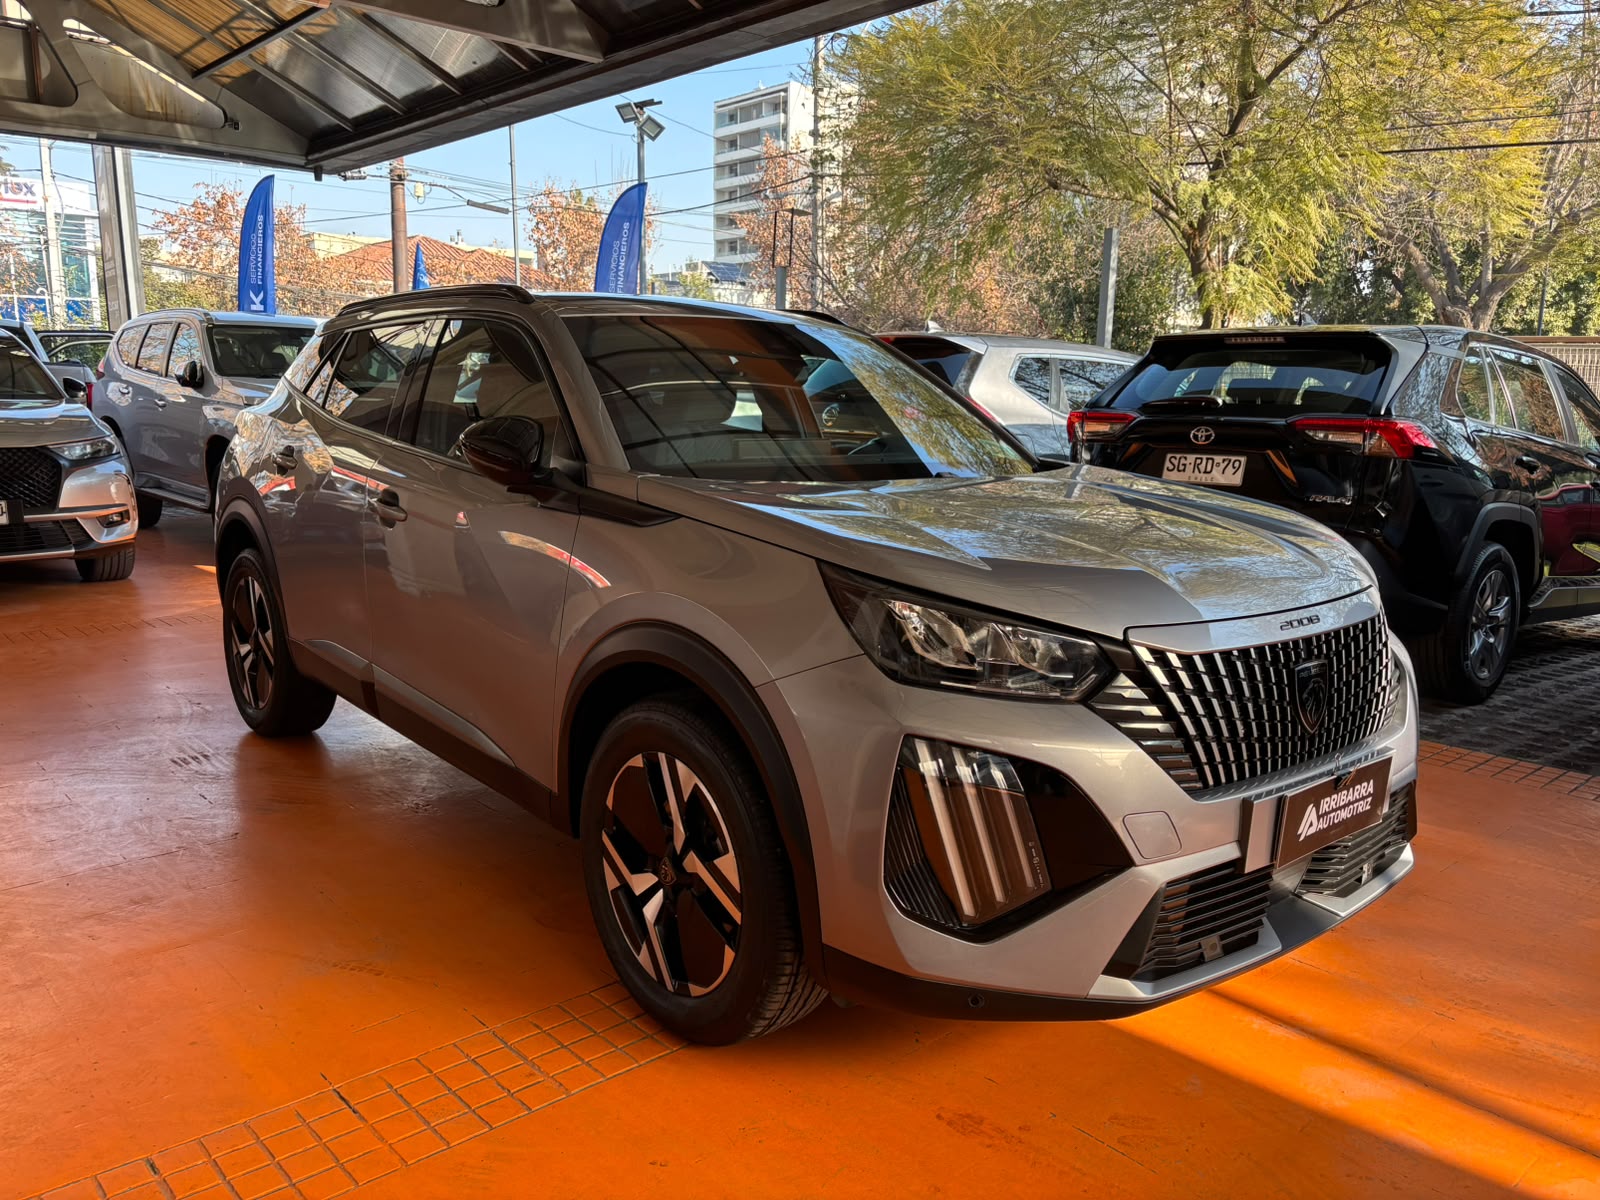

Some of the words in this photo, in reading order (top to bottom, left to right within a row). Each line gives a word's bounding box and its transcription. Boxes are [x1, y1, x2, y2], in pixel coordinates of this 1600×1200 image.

[609, 240, 620, 293] SERVICIOS
[617, 222, 630, 294] FINANCIEROS
[1317, 796, 1373, 832] AUTOMOTRIZ
[1319, 779, 1374, 816] IRRIBARRA
